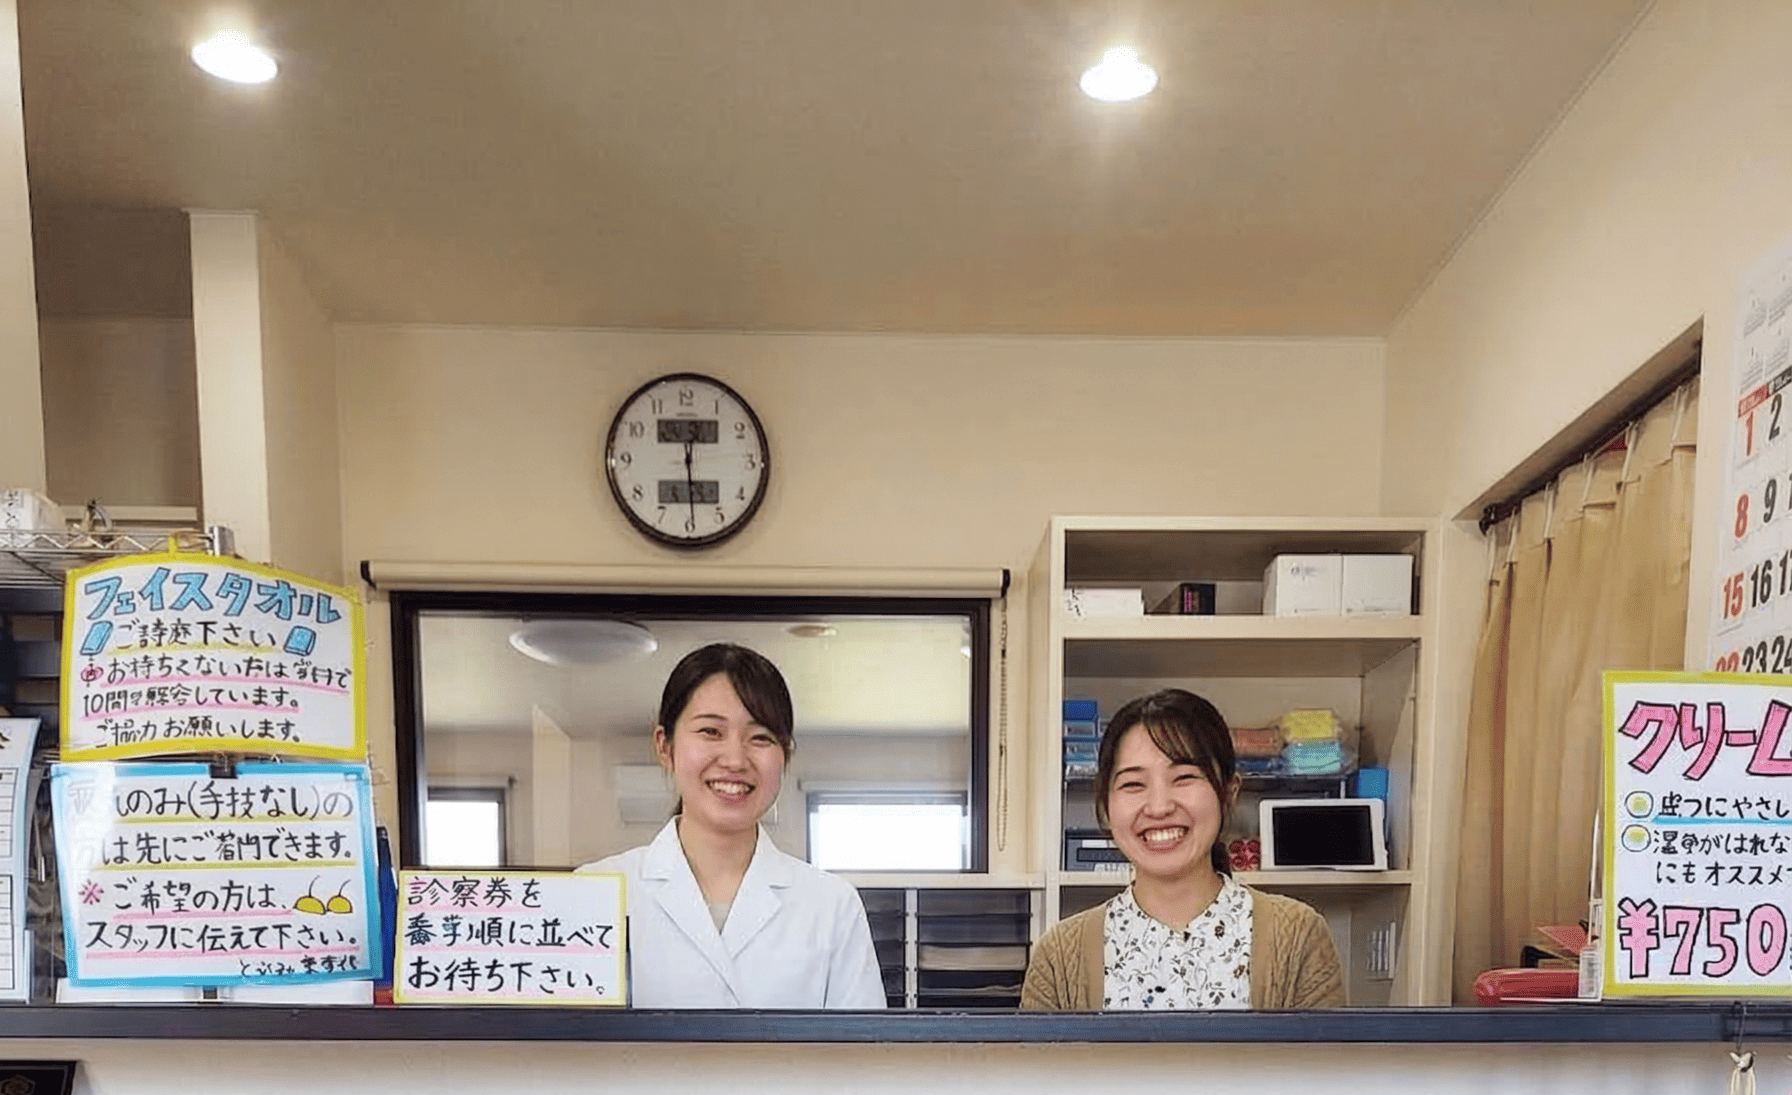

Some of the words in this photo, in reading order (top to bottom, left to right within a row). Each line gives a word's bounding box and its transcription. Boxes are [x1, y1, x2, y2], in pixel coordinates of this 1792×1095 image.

[1745, 410, 1753, 456] 1
[1768, 393, 1782, 440] 2
[1734, 494, 1749, 538] 8
[1763, 478, 1777, 523] 9
[84, 567, 341, 624] フェイスタオル
[1723, 572, 1744, 619] 15
[1751, 559, 1772, 608] 16
[408, 876, 542, 908] 診察券を
[408, 956, 605, 995] お待ち下さい。
